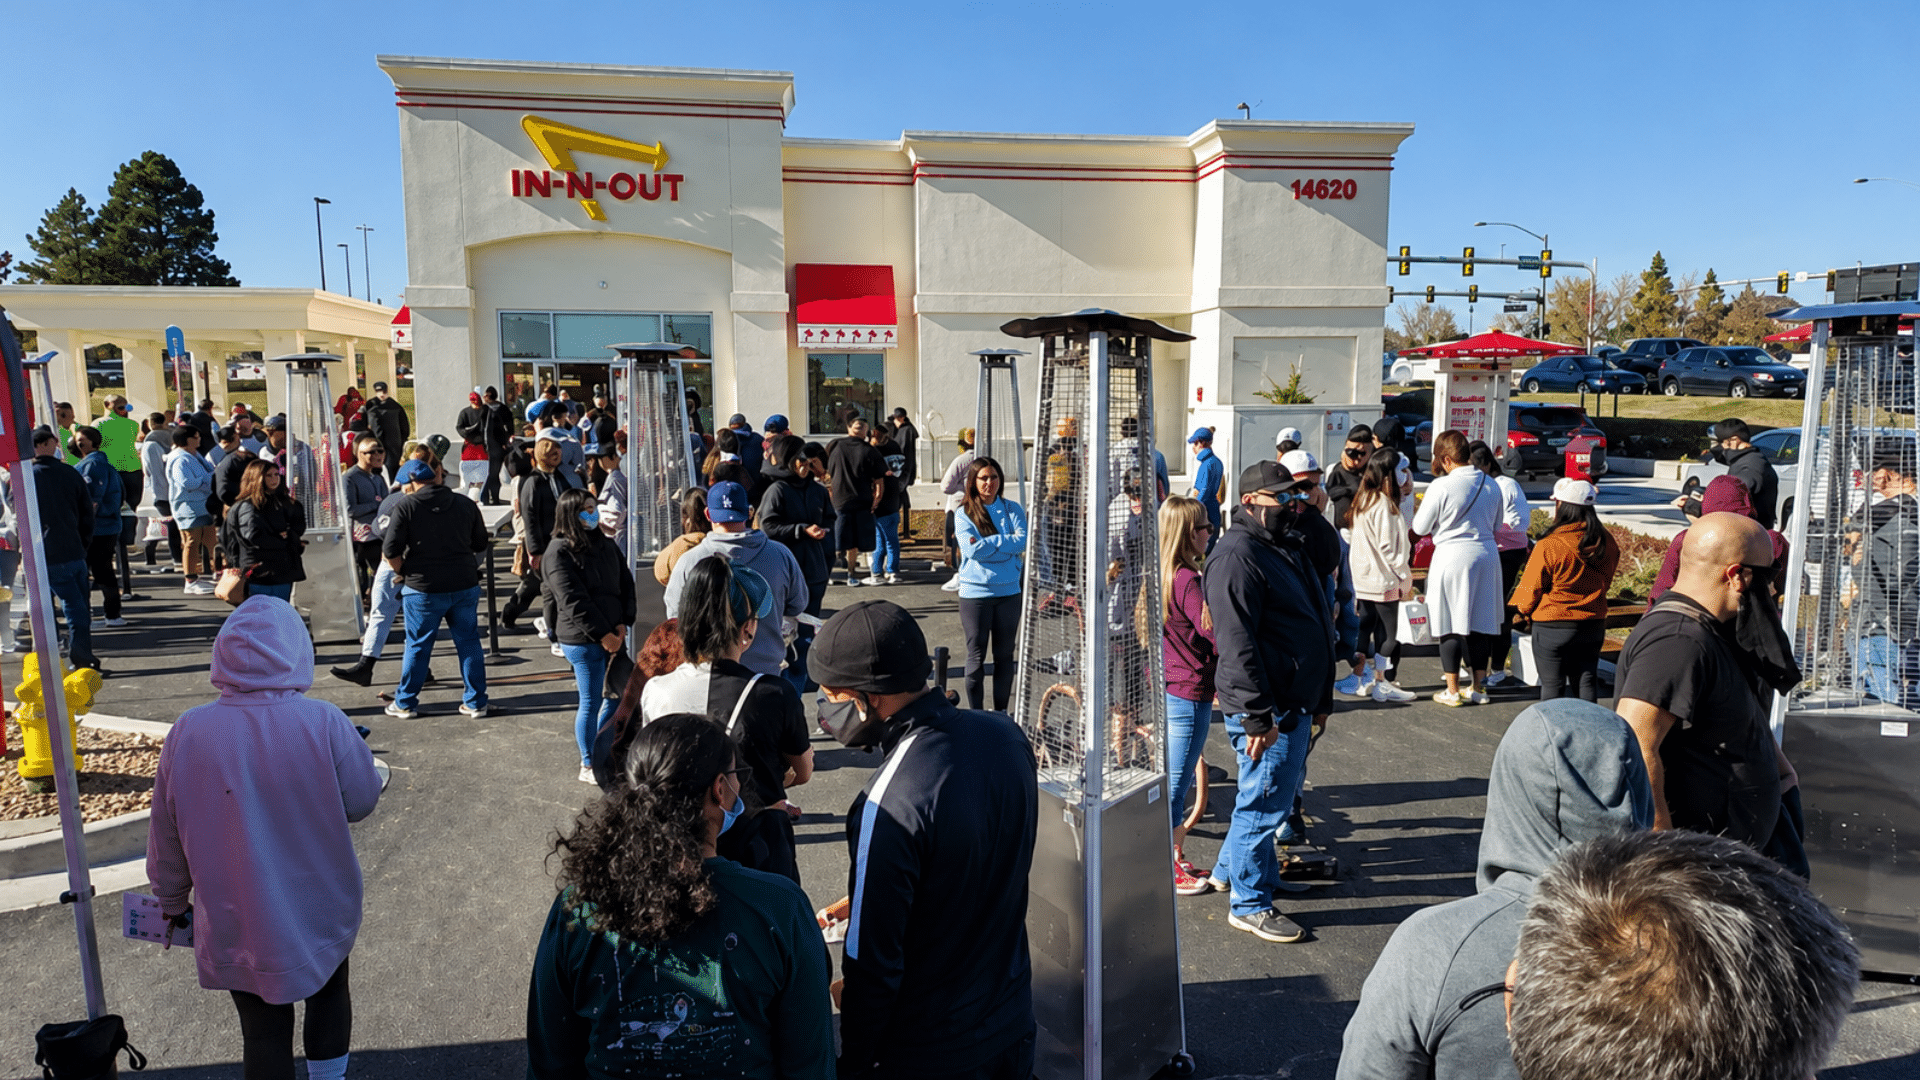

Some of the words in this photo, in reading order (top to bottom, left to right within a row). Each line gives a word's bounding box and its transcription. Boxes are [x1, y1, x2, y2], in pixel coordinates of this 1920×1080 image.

[511, 169, 684, 201] IN-N-OUT
[1290, 178, 1358, 200] 14620
[722, 494, 732, 508] LA
